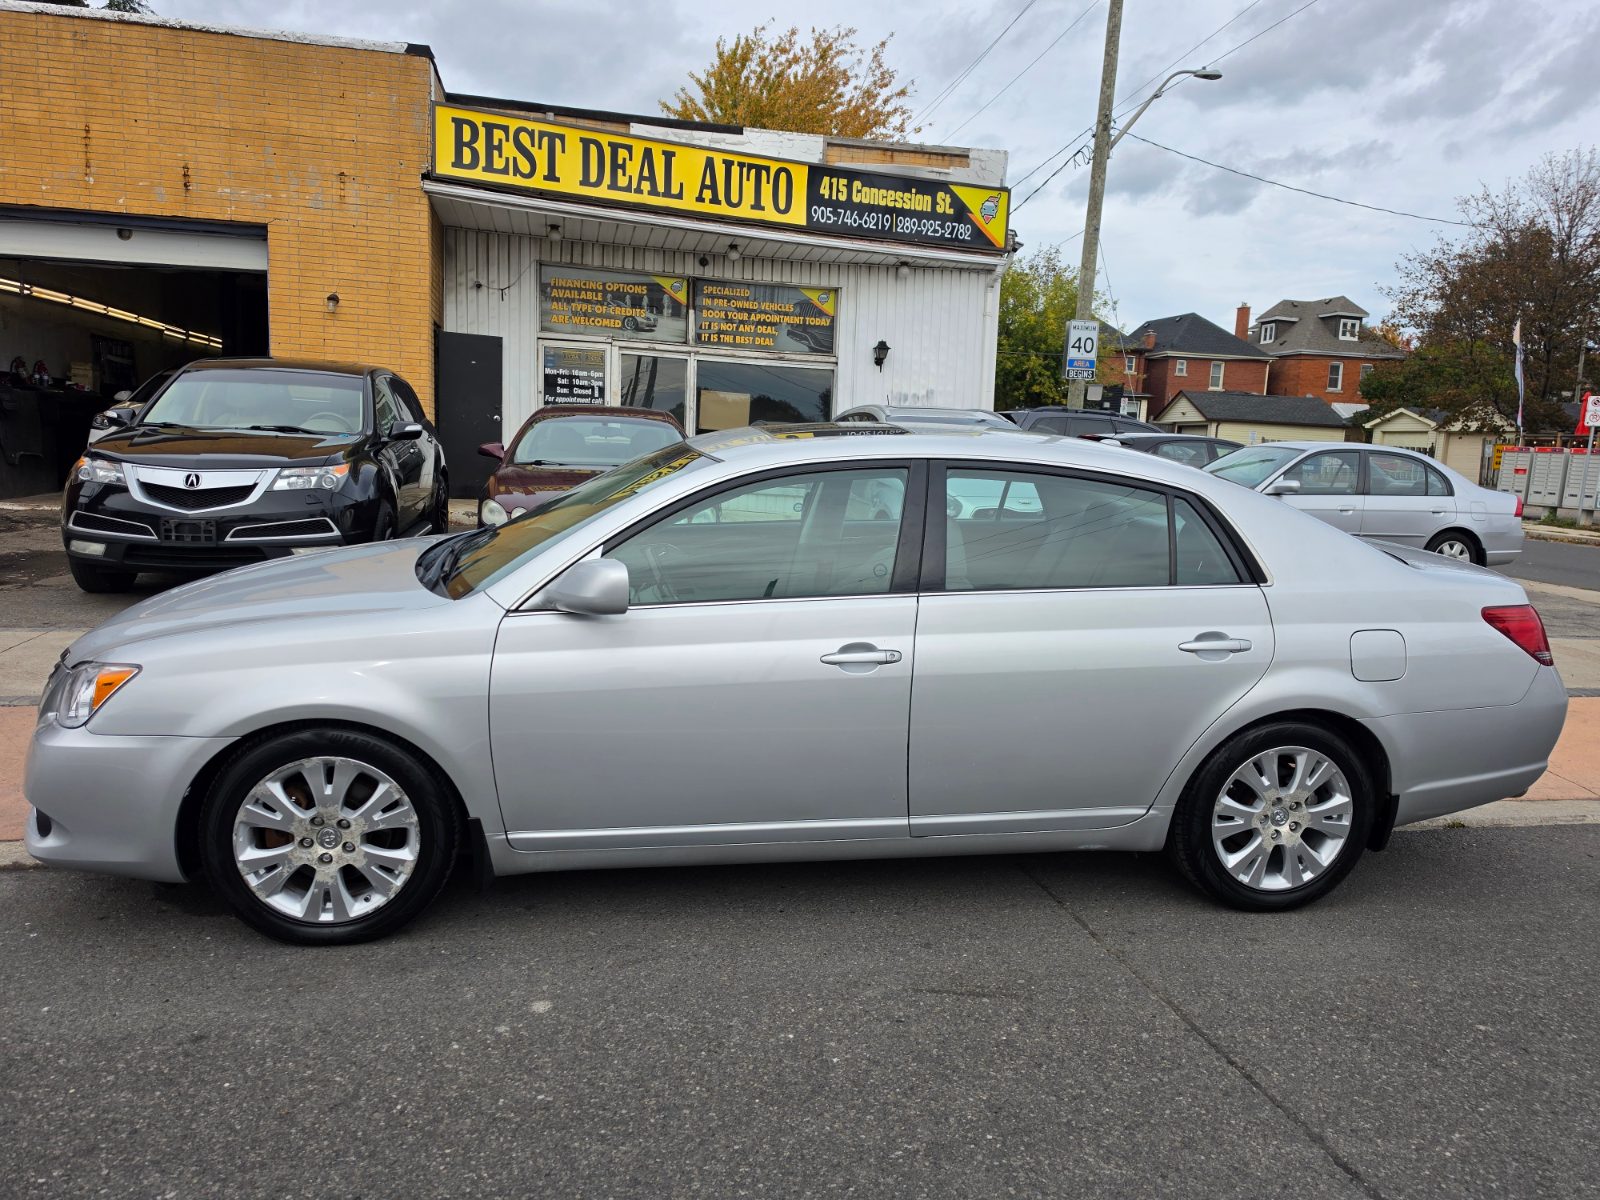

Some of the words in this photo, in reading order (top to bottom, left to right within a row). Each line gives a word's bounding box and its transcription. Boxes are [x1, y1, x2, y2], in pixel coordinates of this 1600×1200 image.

[450, 117, 566, 183] BEST
[579, 136, 684, 201] DEAL
[695, 156, 794, 215] AUTO
[820, 176, 848, 201] 415
[852, 180, 931, 212] Concession
[936, 191, 954, 214] St.
[811, 206, 891, 231] 905-746-6219
[896, 217, 971, 240] 289-925-2782
[551, 278, 603, 290] FINANCING
[606, 283, 647, 294] OPTIONS
[703, 285, 750, 297] SPECIALIZED
[551, 289, 603, 301] AVAILABLE
[551, 302, 568, 311] ALL
[571, 303, 592, 313] TYPE
[595, 305, 607, 314] OF
[610, 307, 647, 318] CREDITS
[703, 298, 711, 306] IN
[713, 299, 758, 309] PRE-OWNED
[761, 302, 794, 312] VEHICLES
[551, 314, 569, 324] ARE
[572, 315, 622, 328] WELCOMED
[702, 310, 725, 319] BOOK
[727, 311, 749, 320] YOUR
[750, 314, 804, 325] APPOINTMENT
[806, 317, 831, 326] TODAY
[702, 321, 710, 330] IT
[711, 322, 719, 330] IS
[720, 323, 737, 331] NOT
[739, 324, 756, 333] ANY
[757, 326, 778, 336] DEAL,
[702, 333, 710, 341] IT
[720, 335, 734, 343] THE
[735, 336, 753, 344] BEST
[755, 337, 774, 346] DEAL
[1071, 337, 1094, 353] 40
[1069, 370, 1093, 378] BEGINS
[573, 387, 592, 395] Closed
